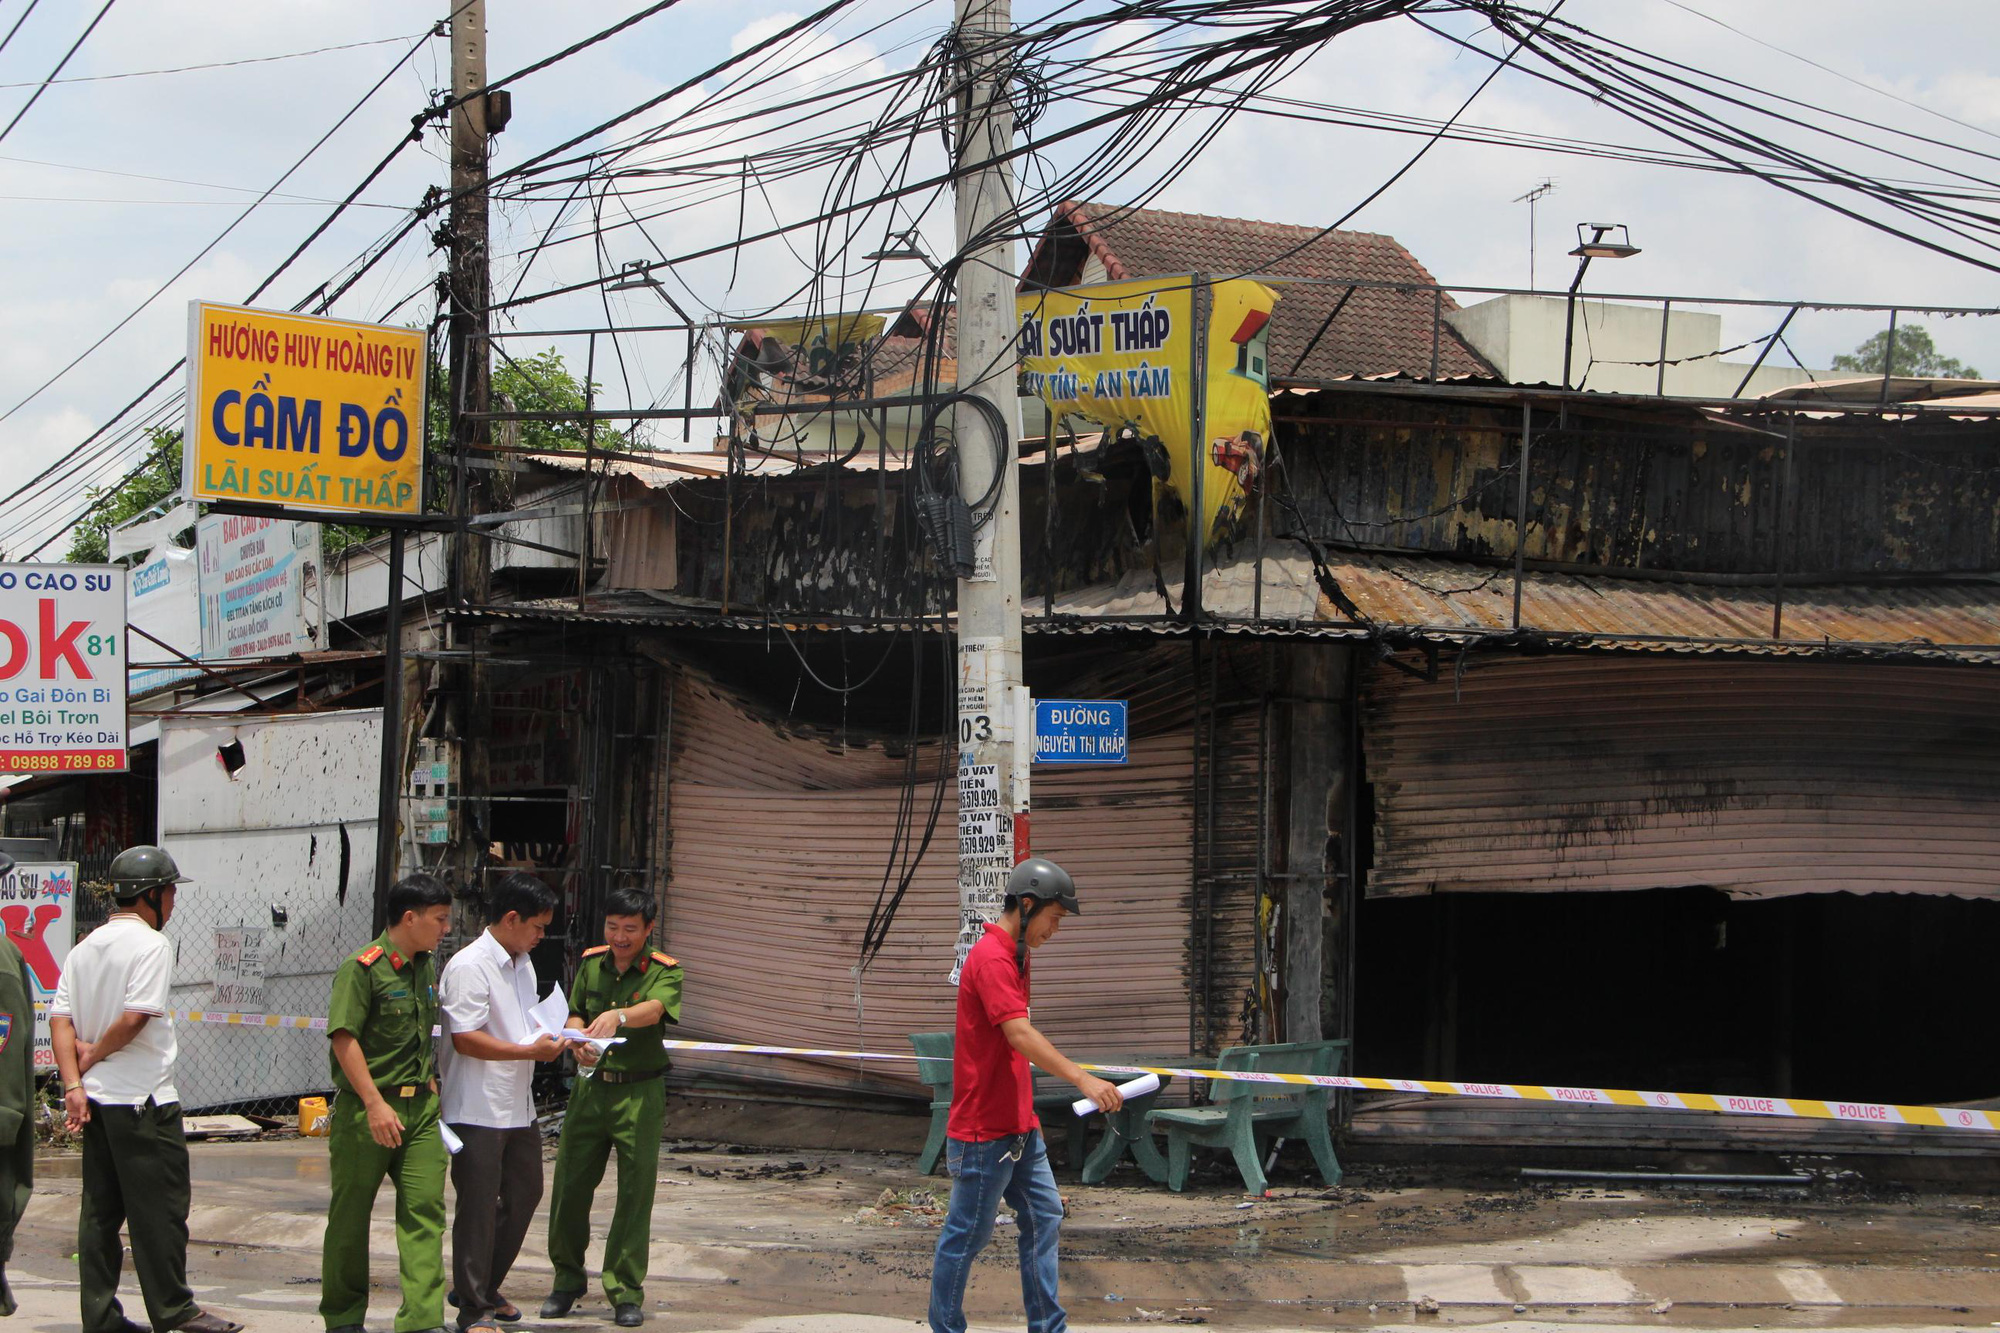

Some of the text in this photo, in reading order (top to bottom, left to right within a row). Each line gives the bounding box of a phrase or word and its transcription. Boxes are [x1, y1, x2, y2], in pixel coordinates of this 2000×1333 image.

[1050, 302, 1103, 356] SUẤT
[1111, 296, 1170, 351] THẤP
[210, 321, 416, 380] HƯƠNG HUY HOÀNG IV
[1049, 366, 1076, 400] TÍN
[1094, 372, 1122, 398] AN
[1128, 362, 1169, 397] TÂM
[212, 373, 408, 462] CẦM ĐỒ
[205, 459, 413, 508] LÃI SUẤT THẤP
[223, 516, 238, 544] BAO
[25, 572, 77, 591] CAO
[85, 574, 111, 591] SU
[225, 570, 234, 584] BAO
[235, 567, 244, 580] CAO
[87, 634, 116, 656] 81
[15, 688, 45, 702] Gai
[51, 688, 86, 702] Đôn
[93, 688, 111, 702] Bi
[22, 710, 51, 725] Bôi
[58, 711, 99, 725] Trơn
[1051, 705, 1110, 725] ĐƯỜNG
[15, 730, 33, 744] Hỗ
[38, 732, 62, 746] Trợ
[66, 732, 92, 743] Kéo
[98, 732, 119, 743] Dài
[961, 716, 992, 744] 03
[1037, 727, 1124, 756] NGUYỄN THỊ KHẮP
[11, 755, 59, 769] 09898
[64, 755, 92, 768] 789
[97, 755, 116, 768] 68
[972, 766, 995, 776] VAY
[970, 812, 992, 822] VAY
[42, 880, 72, 894] 24/24
[983, 872, 999, 886] VAY
[1234, 1072, 1270, 1080] POLICE
[1317, 1076, 1352, 1086] POLICE
[1464, 1083, 1502, 1096] POLICE
[1557, 1088, 1597, 1101] POLICE
[1729, 1098, 1774, 1112] POLICE
[1839, 1104, 1886, 1120] POLICE
